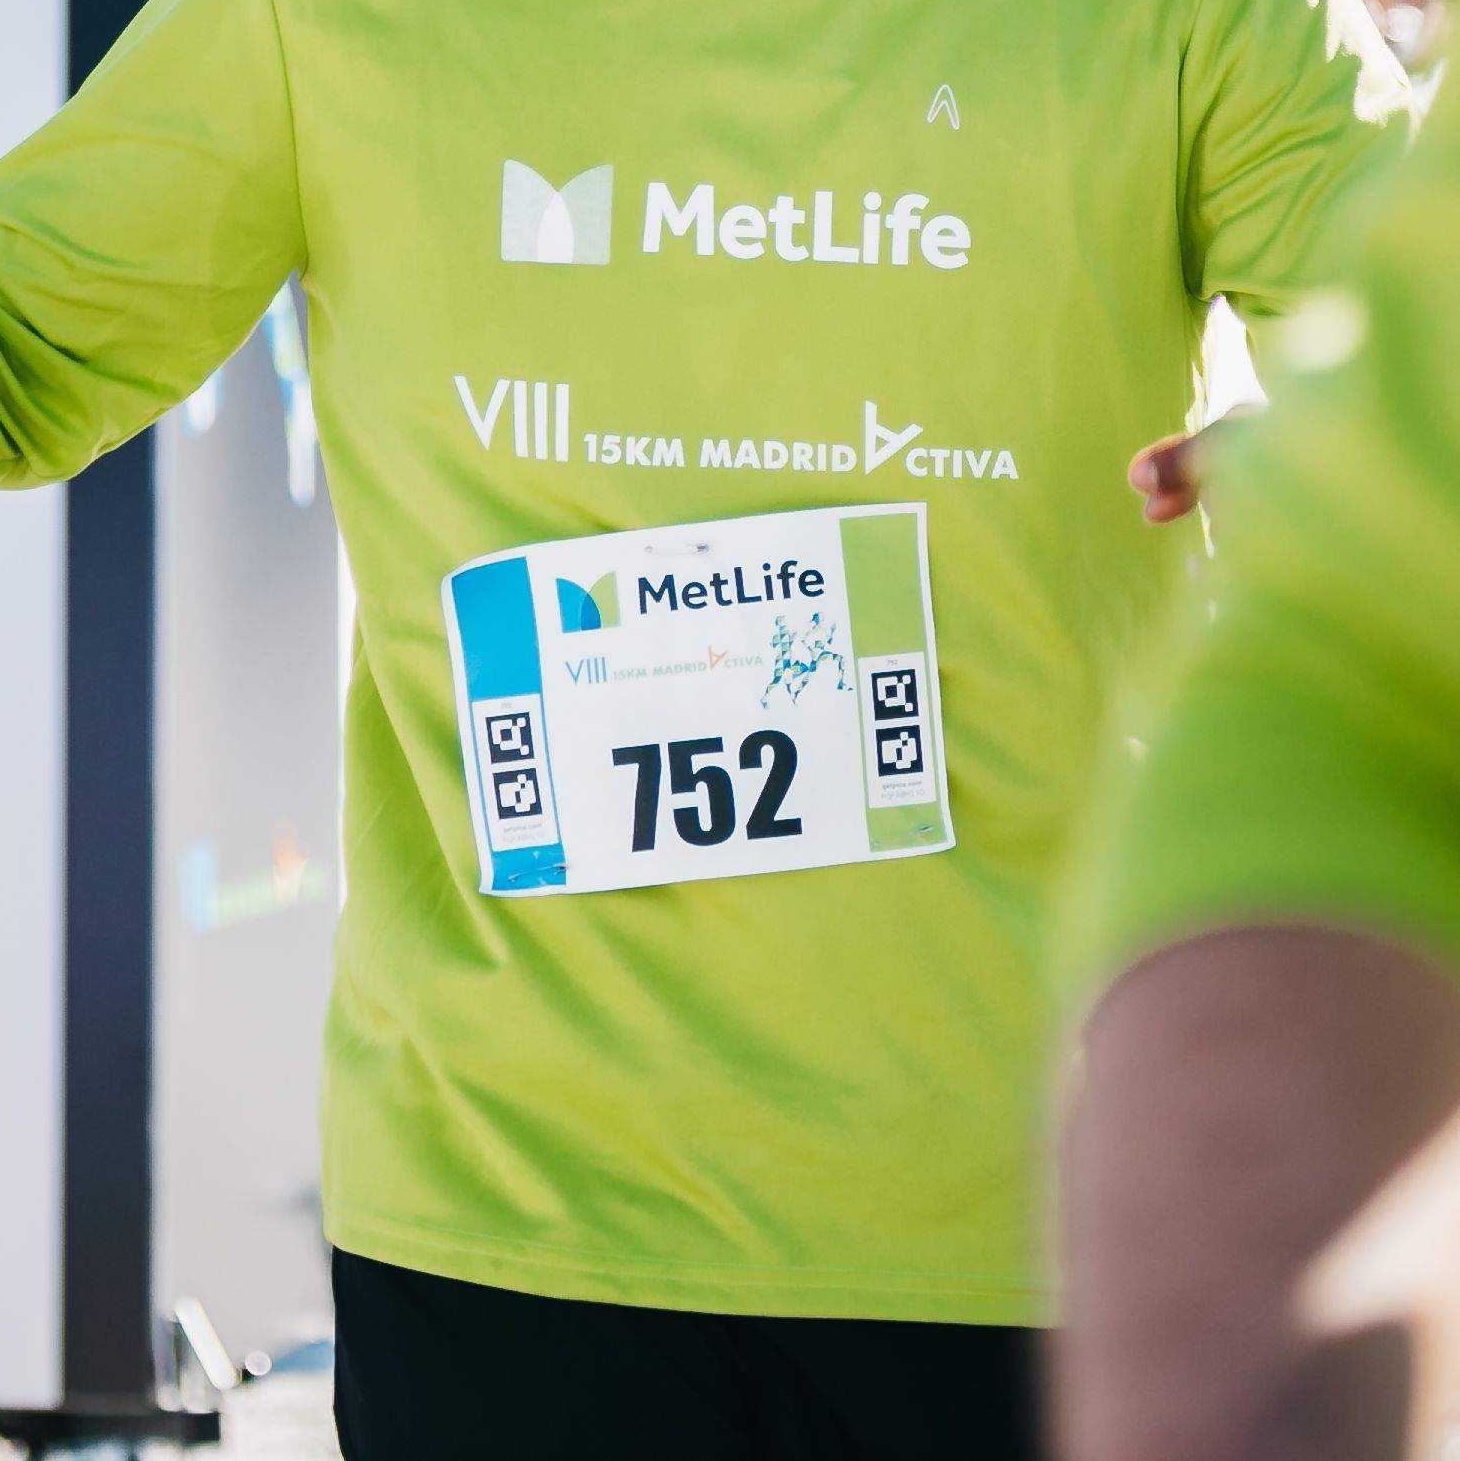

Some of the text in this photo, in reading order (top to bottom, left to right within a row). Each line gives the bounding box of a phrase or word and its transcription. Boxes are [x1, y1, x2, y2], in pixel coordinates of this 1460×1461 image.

[643, 182, 971, 269] MetLife
[454, 375, 570, 462] VIII
[584, 432, 686, 468] 15KM
[639, 560, 825, 615] MetLife
[565, 656, 608, 685] VIII
[613, 667, 647, 682] 15KM
[612, 728, 803, 853] 752
